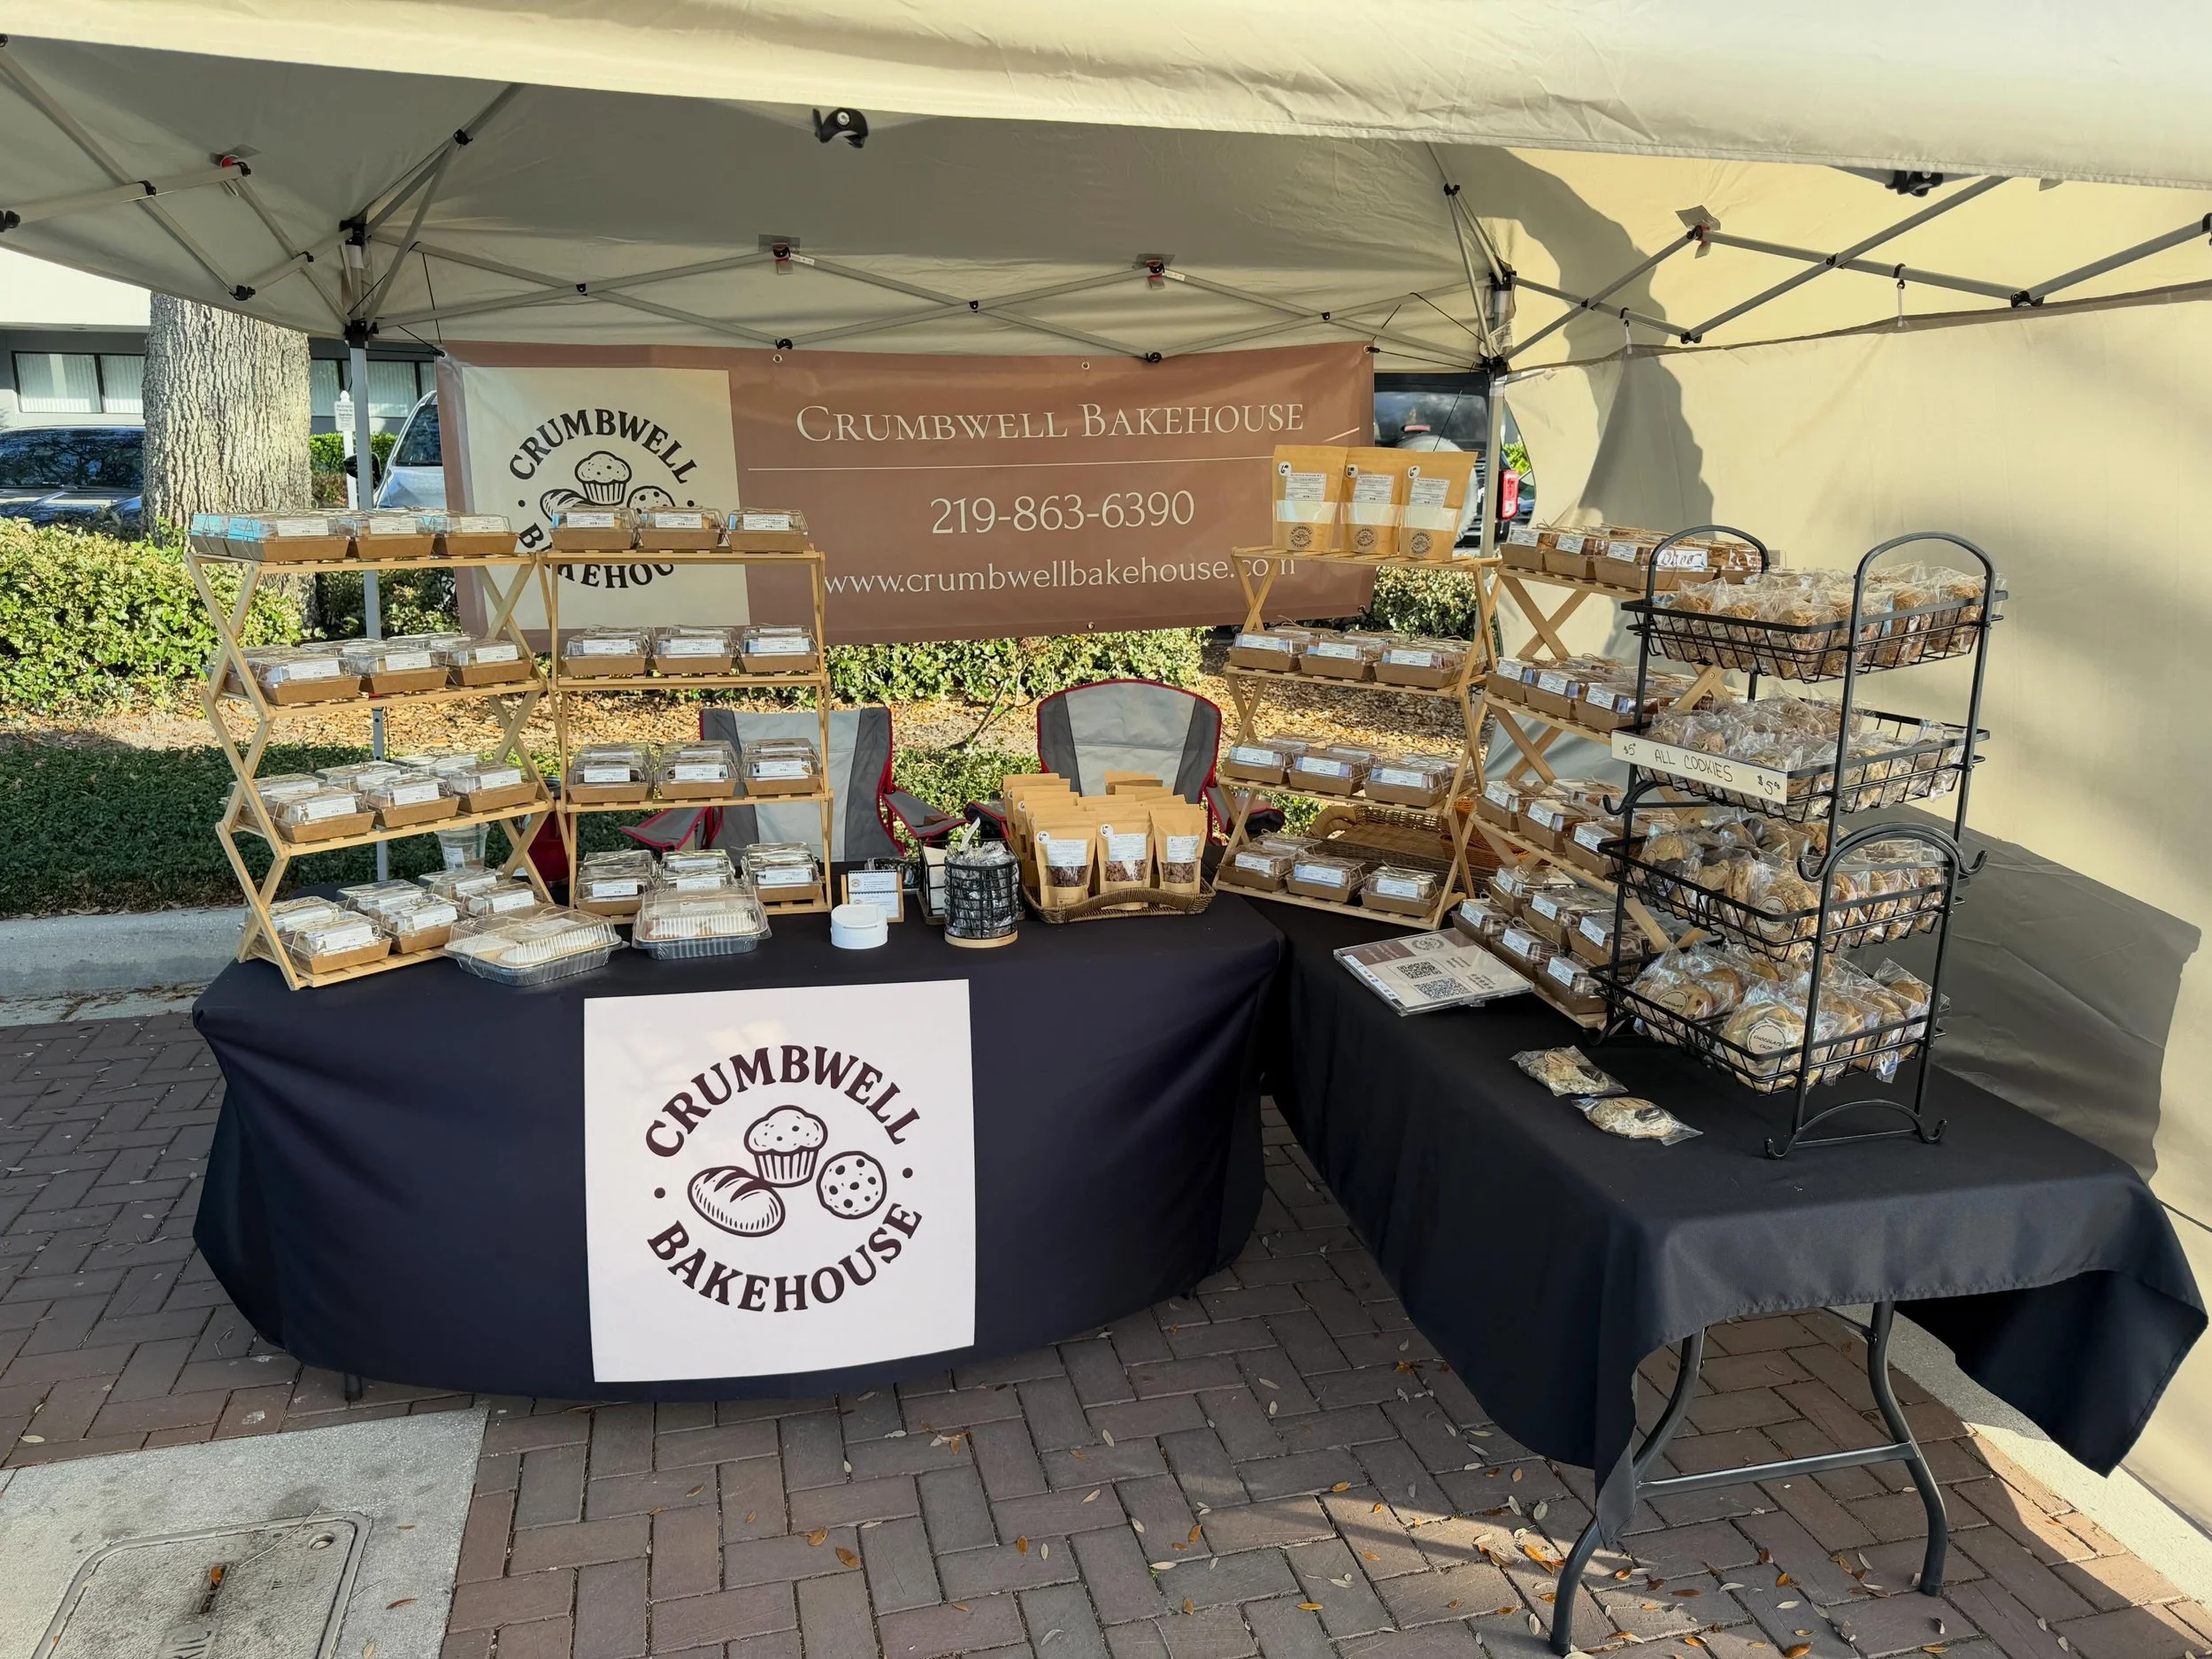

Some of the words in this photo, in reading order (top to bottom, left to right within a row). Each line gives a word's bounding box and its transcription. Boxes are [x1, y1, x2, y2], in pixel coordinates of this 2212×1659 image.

[796, 403, 1068, 442] CRUMBWELL
[1079, 401, 1304, 438] BAKEHOUSE
[509, 408, 699, 485] CRUMBWELL
[930, 489, 1195, 534] 219-863-6390
[1655, 749, 1676, 766] ALL
[1684, 754, 1733, 783] COOKIES
[1753, 1034, 1784, 1048] CHOCOLATE
[645, 1044, 921, 1157] CRUMBWELL
[647, 1202, 923, 1313] BAKEHOUSE
